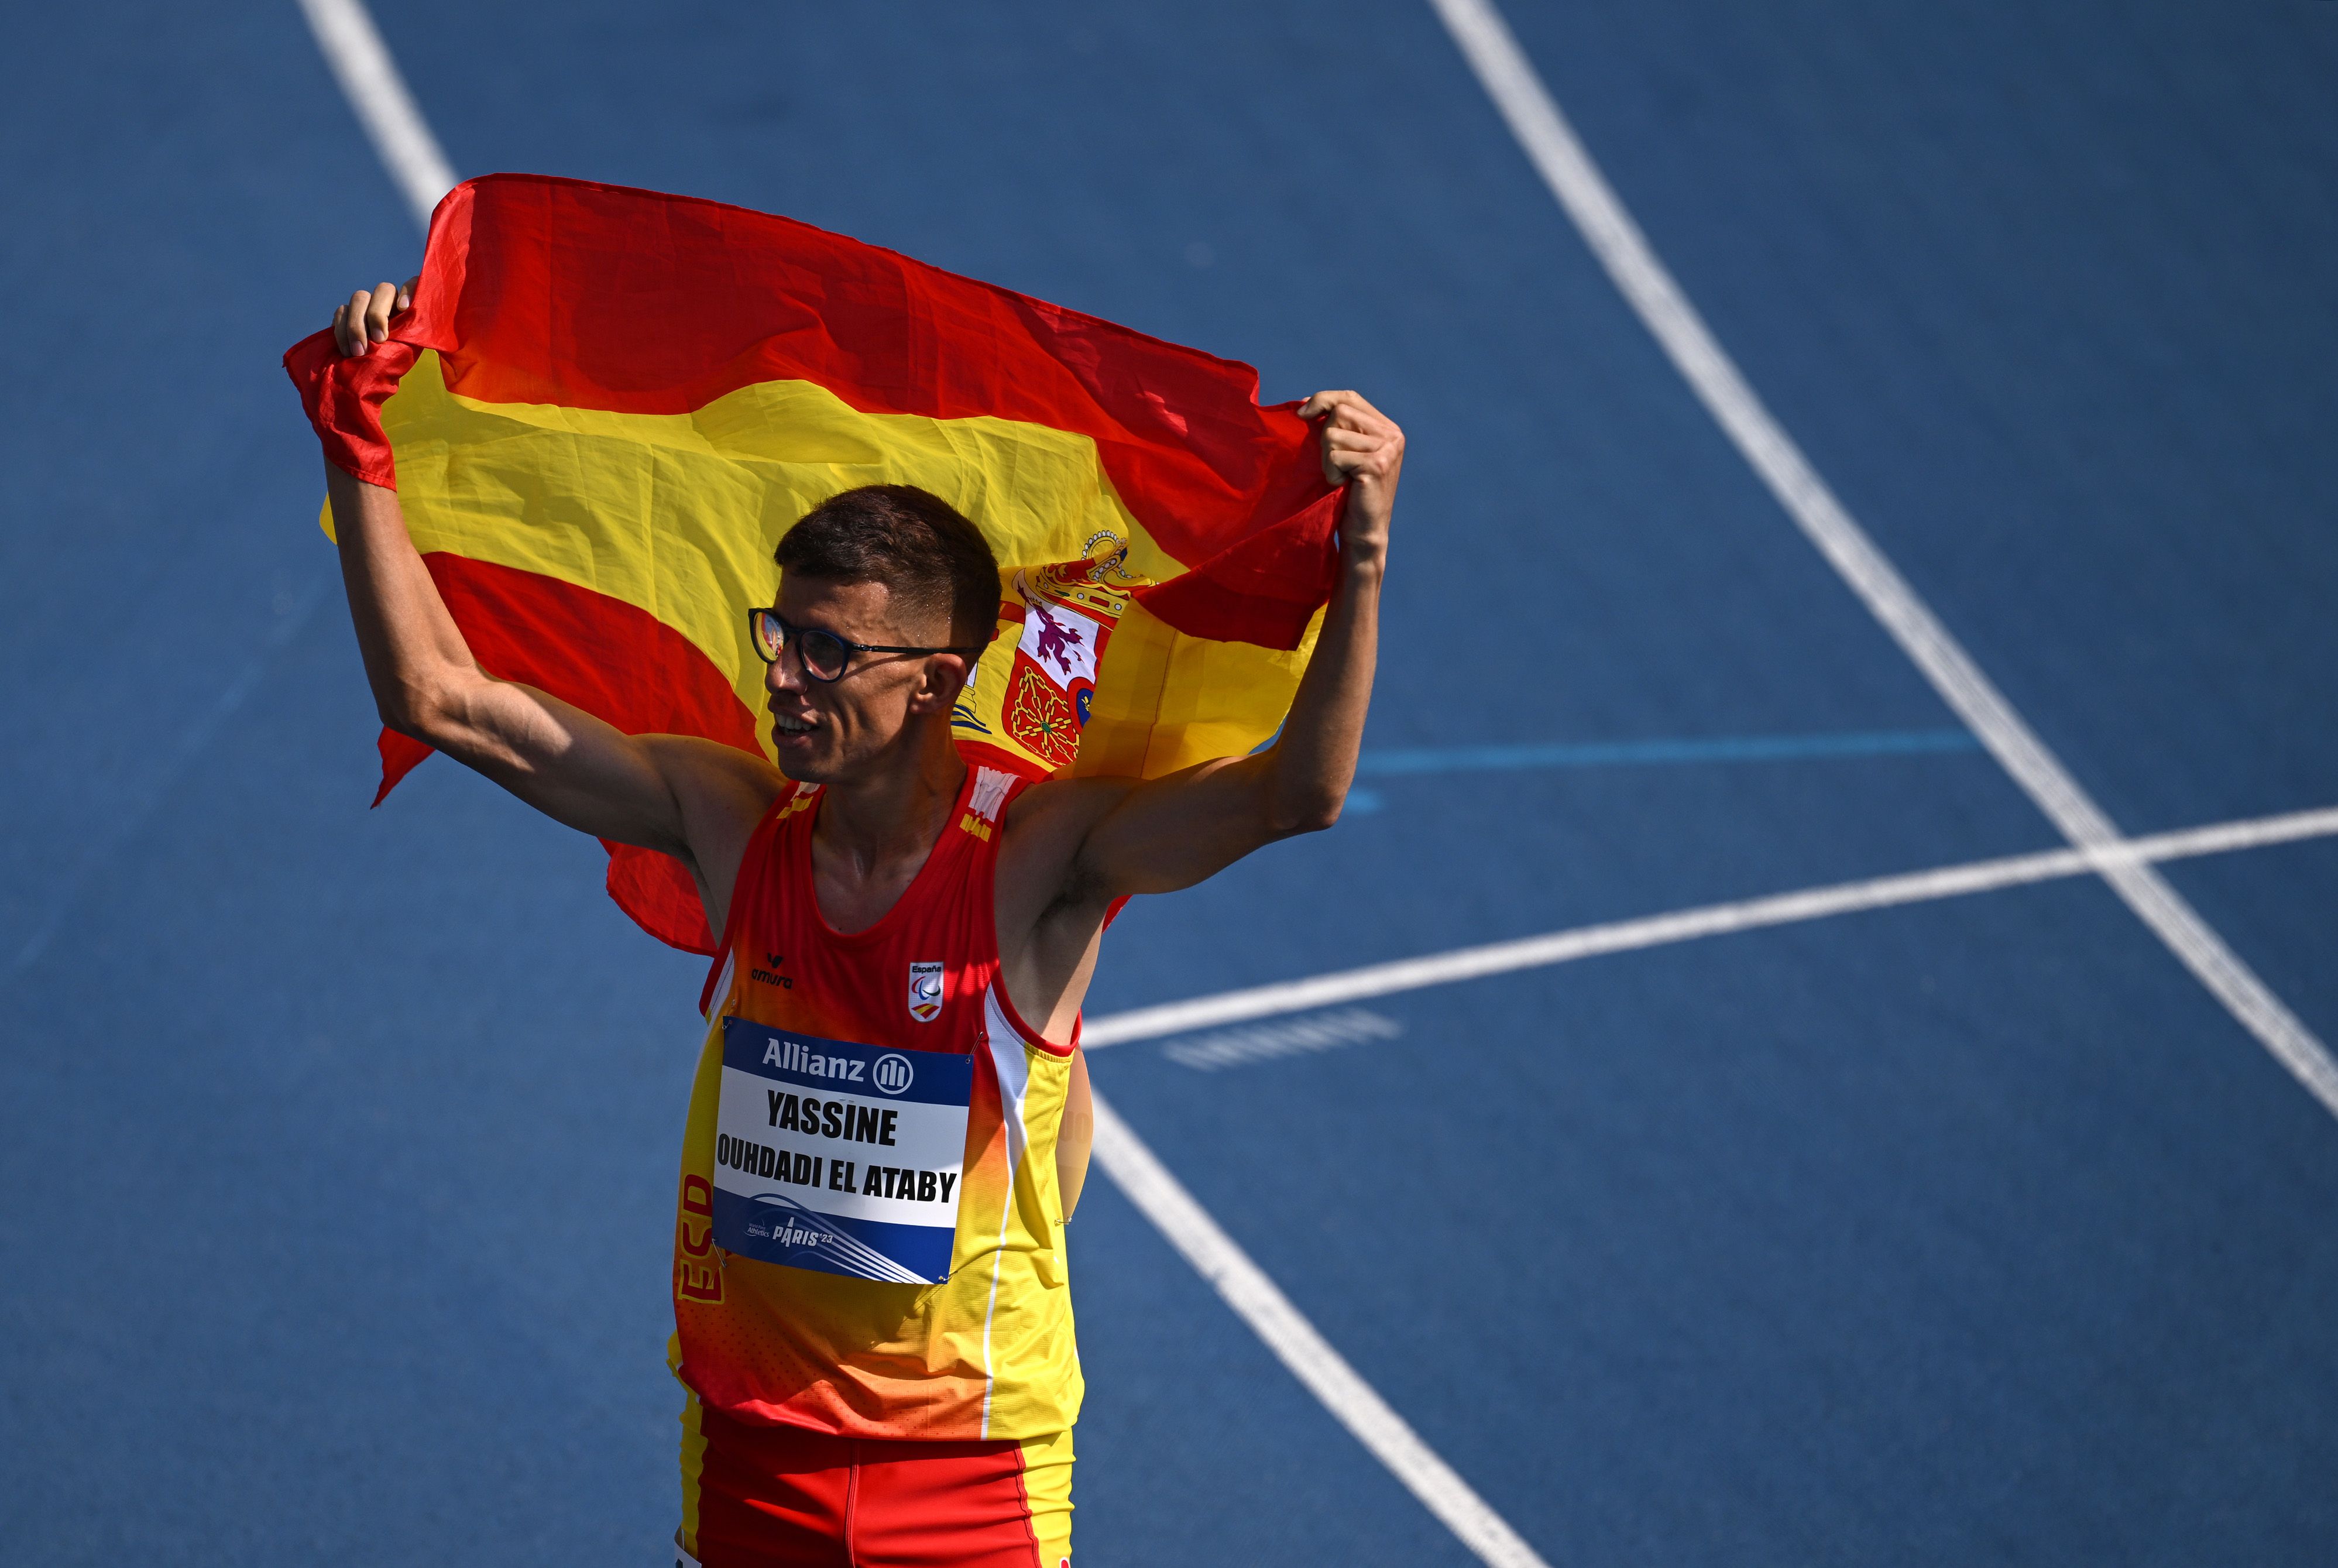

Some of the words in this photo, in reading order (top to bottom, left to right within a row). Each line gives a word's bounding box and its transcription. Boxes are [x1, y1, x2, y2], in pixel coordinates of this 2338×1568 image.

[751, 969, 793, 990] amura
[912, 965, 942, 975] España
[762, 1038, 866, 1082] Allianz
[767, 1089, 898, 1146] YASSINE
[717, 1133, 822, 1188] OUHDADI
[829, 1159, 857, 1194] EL
[862, 1165, 957, 1203] ATABY
[747, 1227, 770, 1237] Athletics
[772, 1217, 819, 1247] PARIS
